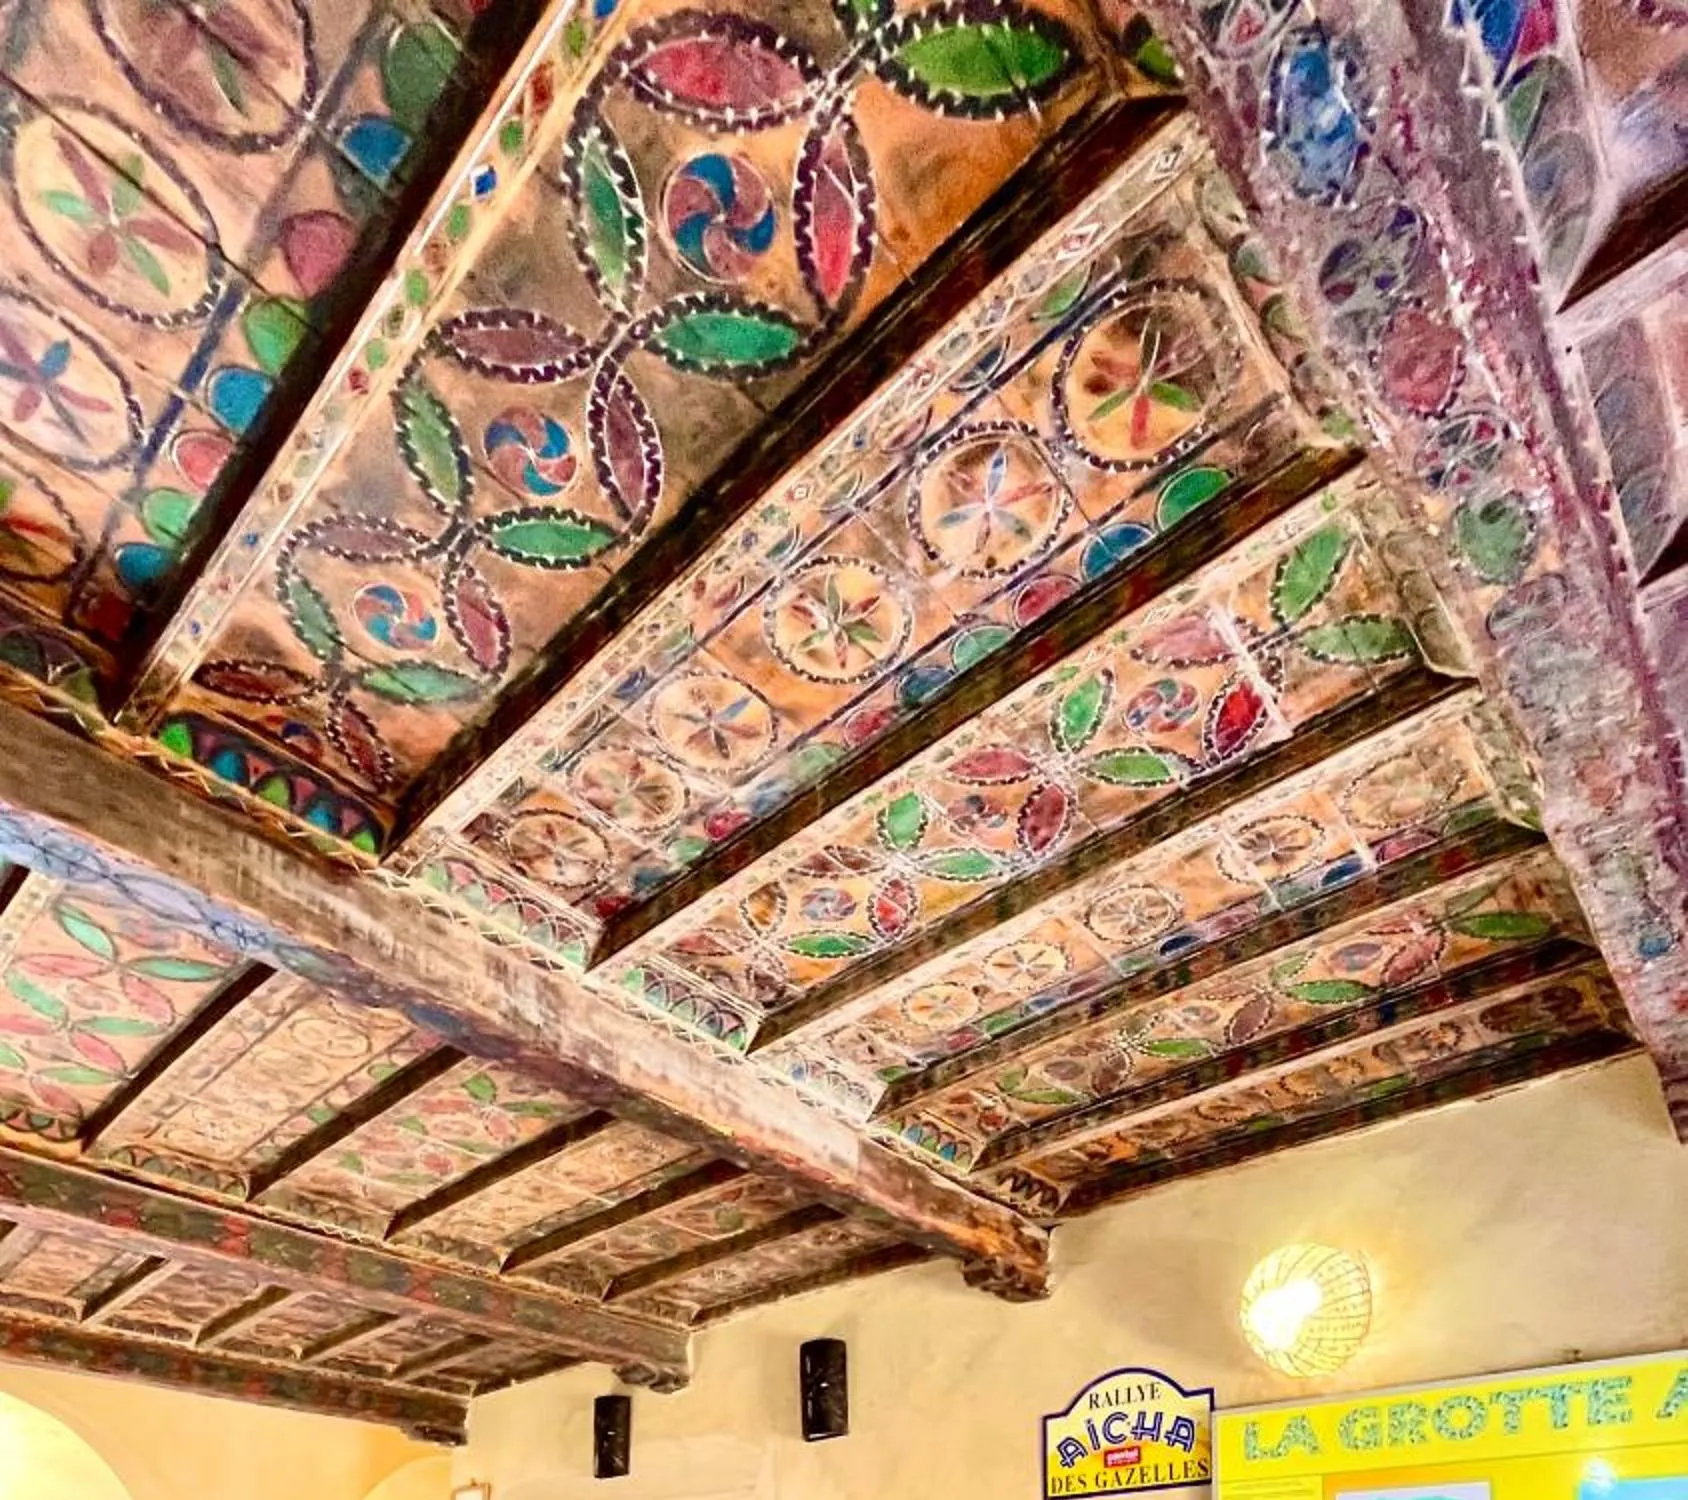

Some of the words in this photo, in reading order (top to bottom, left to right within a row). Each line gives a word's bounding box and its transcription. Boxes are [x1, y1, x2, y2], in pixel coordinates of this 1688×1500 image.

[1089, 1381, 1161, 1409] RALLYE
[1244, 1414, 1322, 1461] LA
[1338, 1376, 1633, 1450] GROTTE
[1051, 1474, 1087, 1494] DES
[1095, 1458, 1209, 1489] GAZELLES
